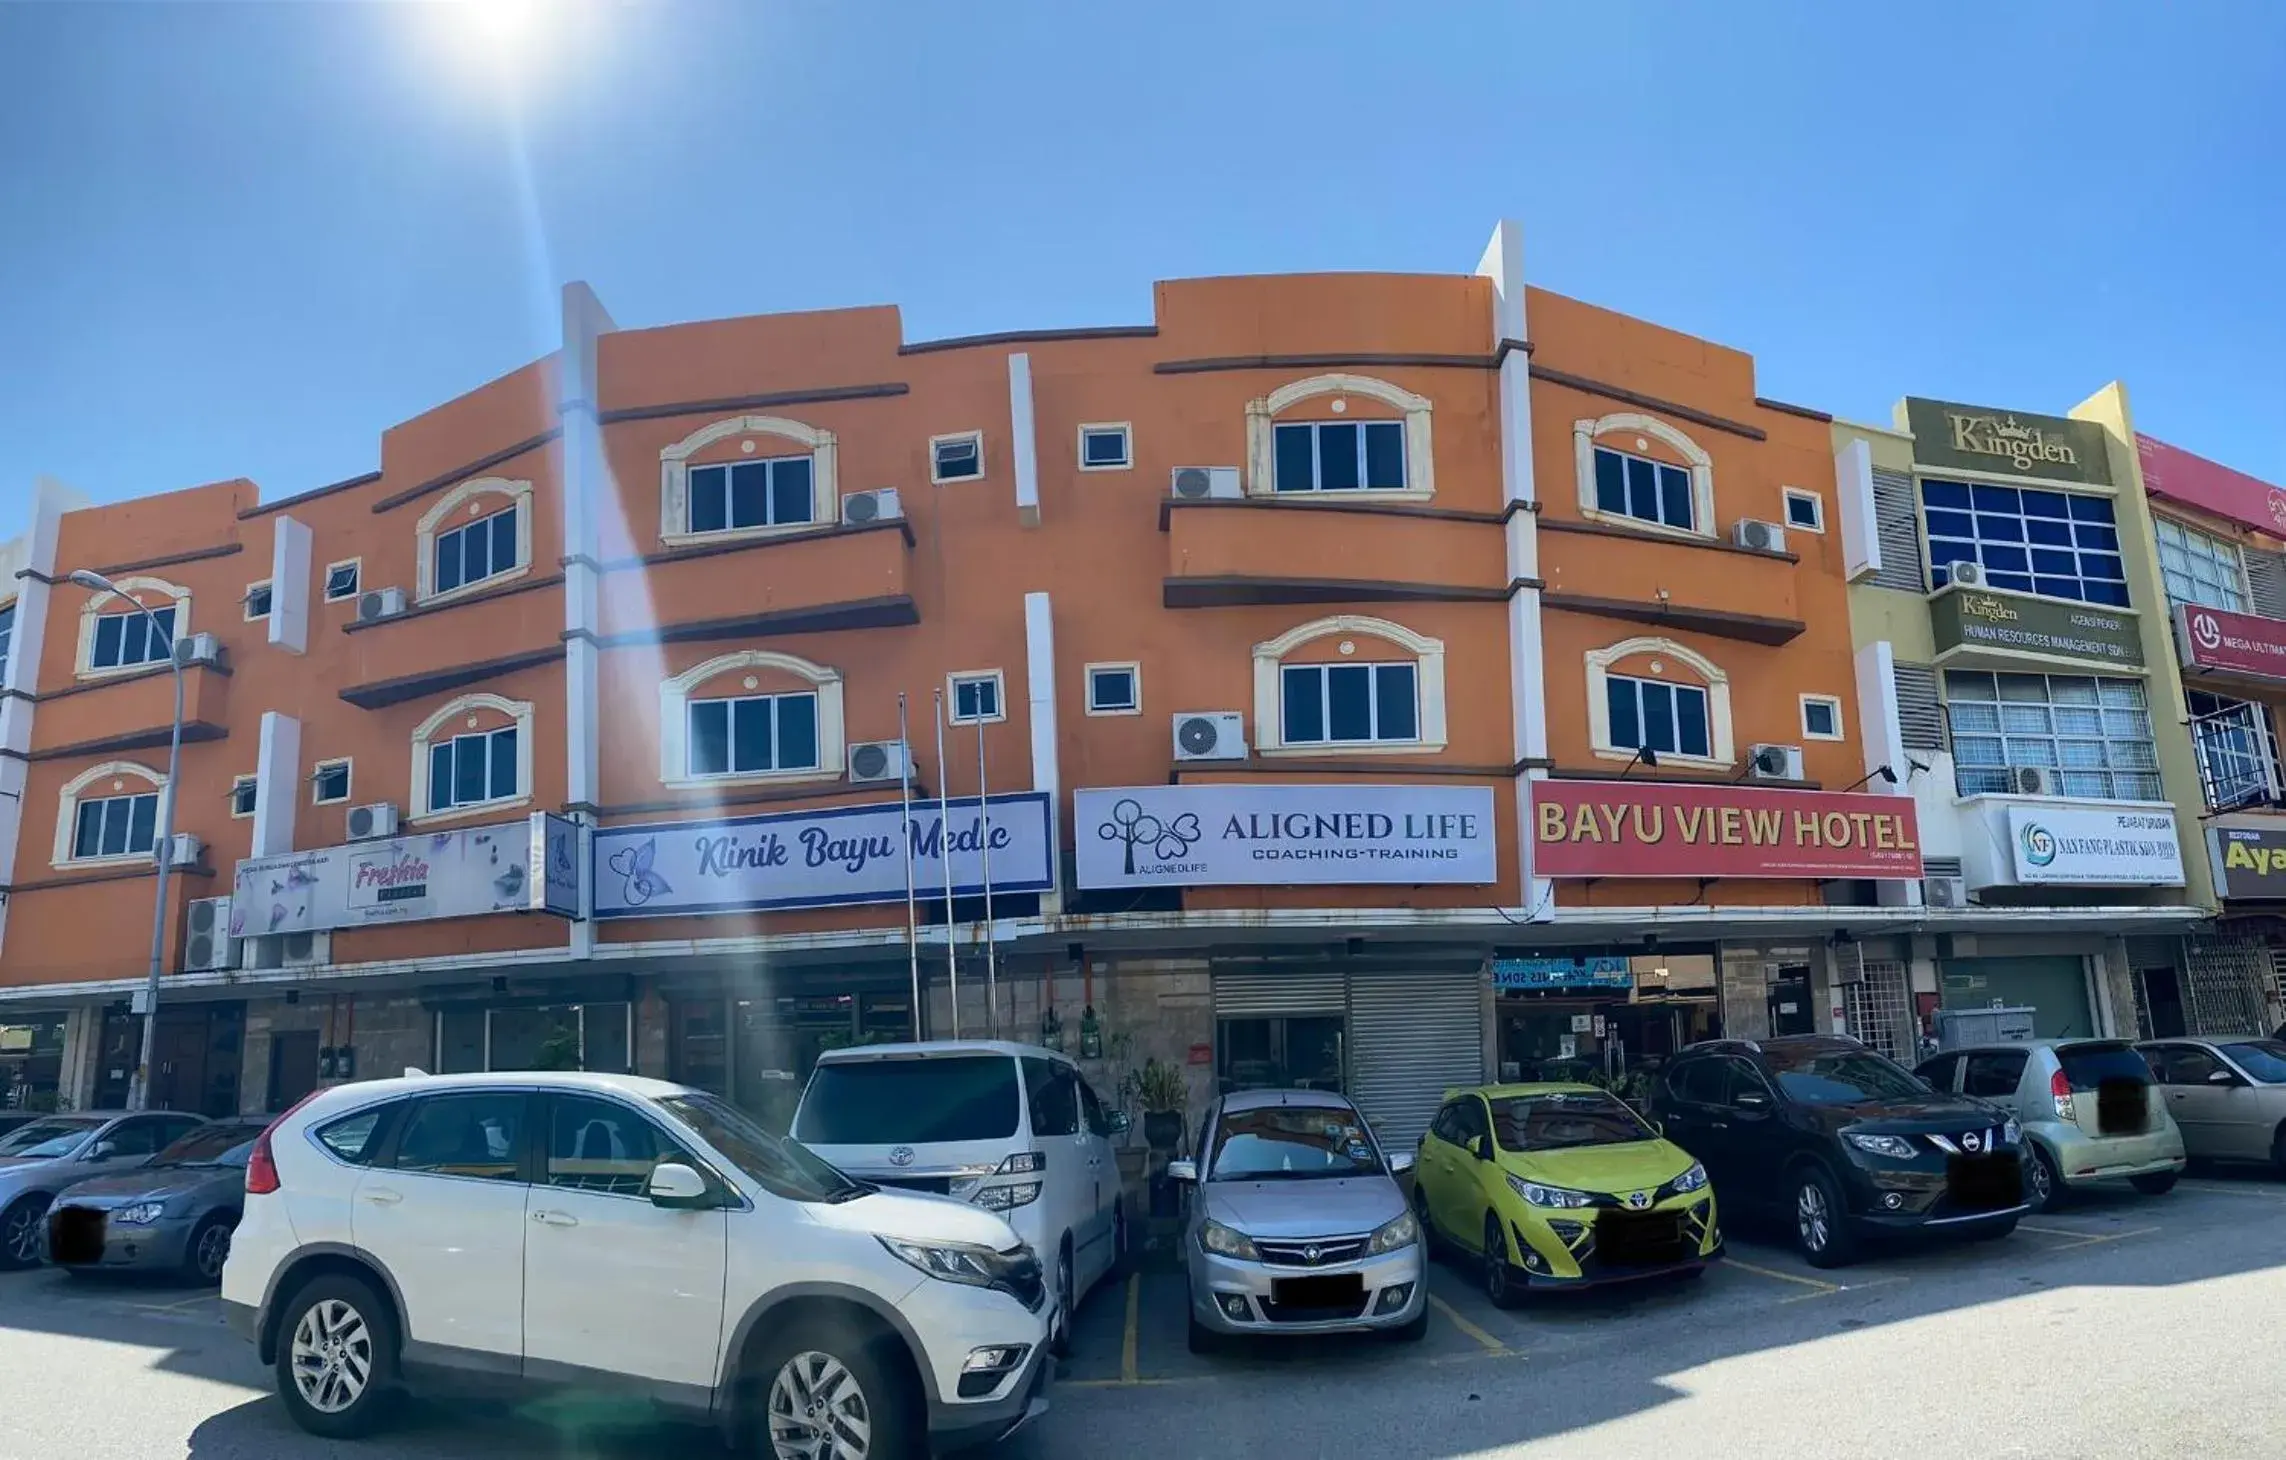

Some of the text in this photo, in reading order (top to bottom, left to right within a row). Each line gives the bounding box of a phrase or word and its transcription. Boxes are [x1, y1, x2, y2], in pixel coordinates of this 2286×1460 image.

[1949, 413, 2077, 471] Kingden
[1963, 624, 1997, 640] HUMAN
[1998, 628, 2050, 647] RESOURCES
[1221, 813, 1479, 841] ALIGNED LIFE
[1538, 801, 1916, 851] BAYU VIEW HOTEL
[694, 831, 789, 879] Klinik
[798, 825, 896, 874] Bayu
[1251, 847, 1459, 860] COACHING-TRAINING
